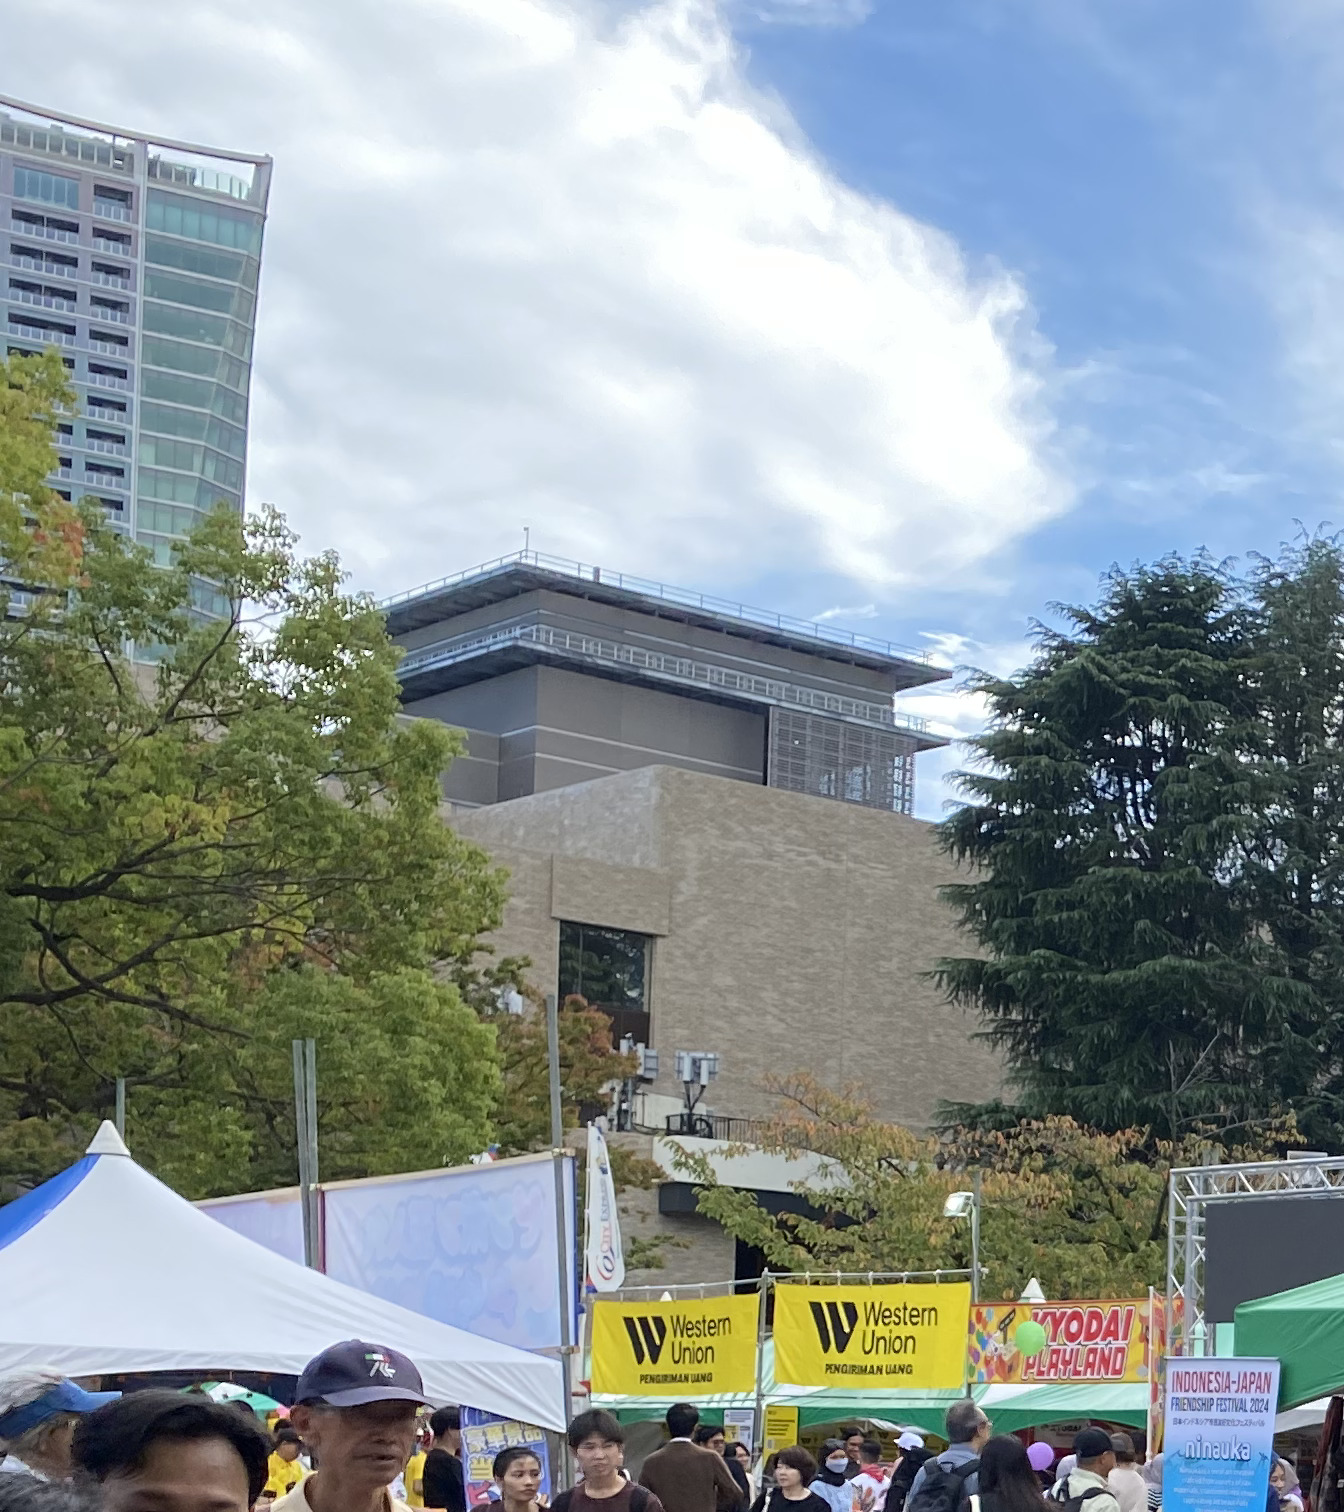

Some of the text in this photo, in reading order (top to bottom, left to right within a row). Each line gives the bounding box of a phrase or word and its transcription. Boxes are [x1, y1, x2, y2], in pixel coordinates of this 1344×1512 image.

[670, 1314, 732, 1339] Western
[862, 1301, 938, 1327] Western
[1032, 1306, 1135, 1345] KYODAI
[670, 1341, 715, 1365] Union
[861, 1330, 916, 1356] Union
[825, 1363, 883, 1376] PENGIRIMAN
[1021, 1345, 1128, 1380] PLAYLAND
[639, 1373, 690, 1385] PENGIRIMAN
[1172, 1371, 1272, 1394] INDONESIA-JAPAN
[1171, 1397, 1269, 1413] FRIENDSHIP FESTIVAL 2024
[1185, 1434, 1251, 1461] ninauka
